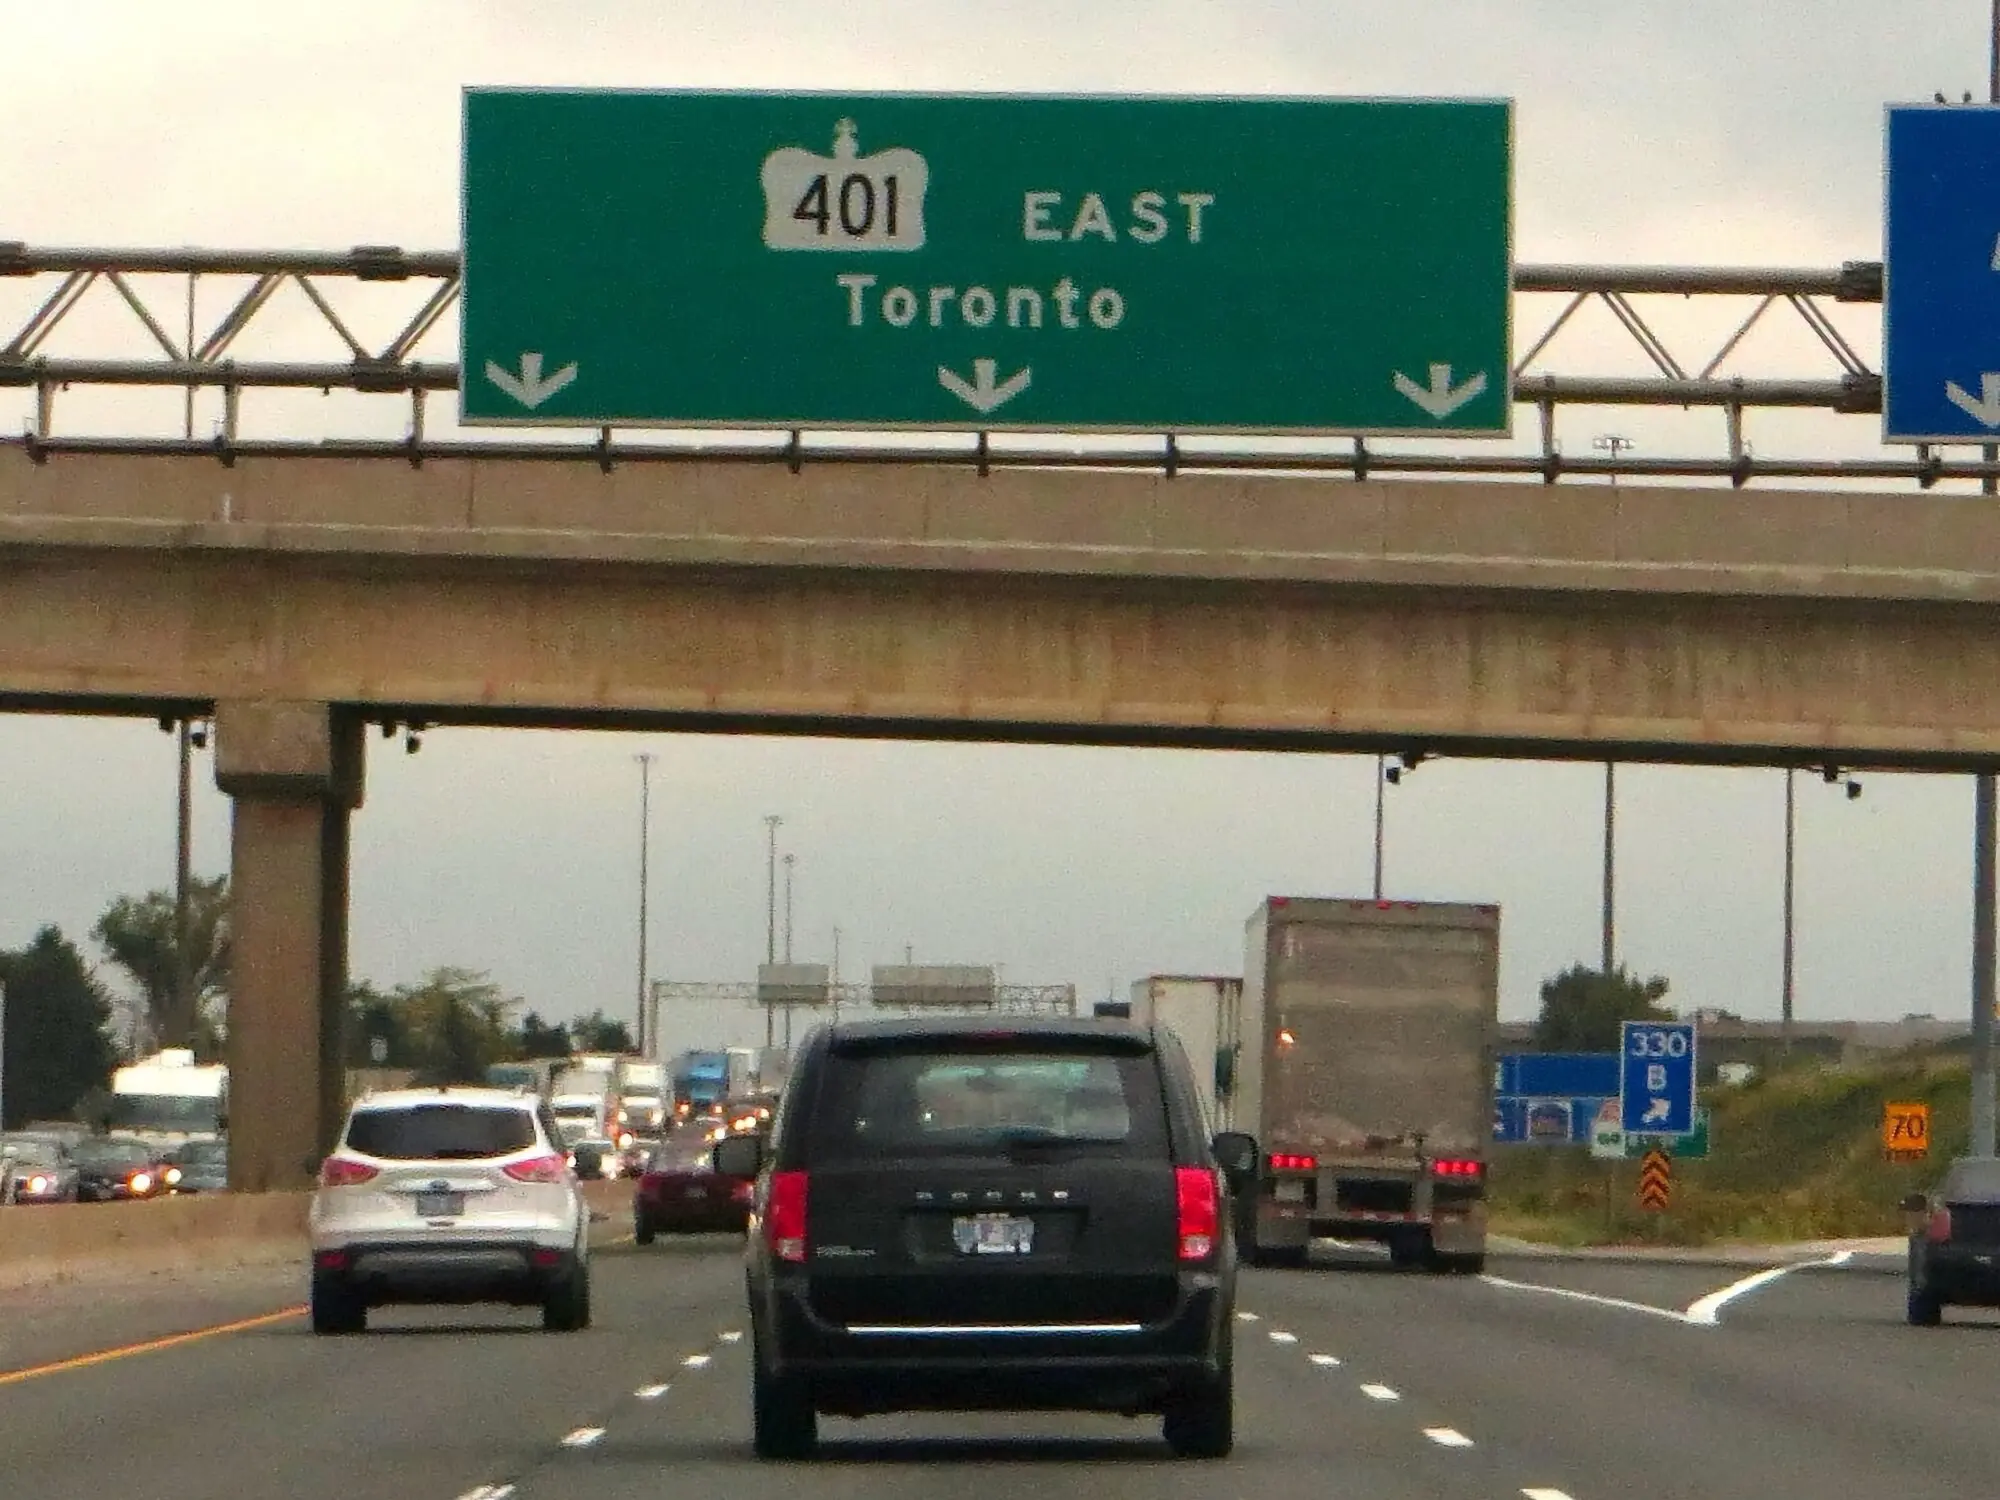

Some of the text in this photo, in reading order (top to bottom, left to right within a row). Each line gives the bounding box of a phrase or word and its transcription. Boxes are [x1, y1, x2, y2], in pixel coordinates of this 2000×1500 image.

[792, 173, 899, 237] 401
[1023, 191, 1215, 243] EAST
[837, 274, 1126, 329] Toronto
[1631, 1031, 1687, 1057] 330
[1646, 1064, 1667, 1091] B
[1891, 1115, 1925, 1139] 70
